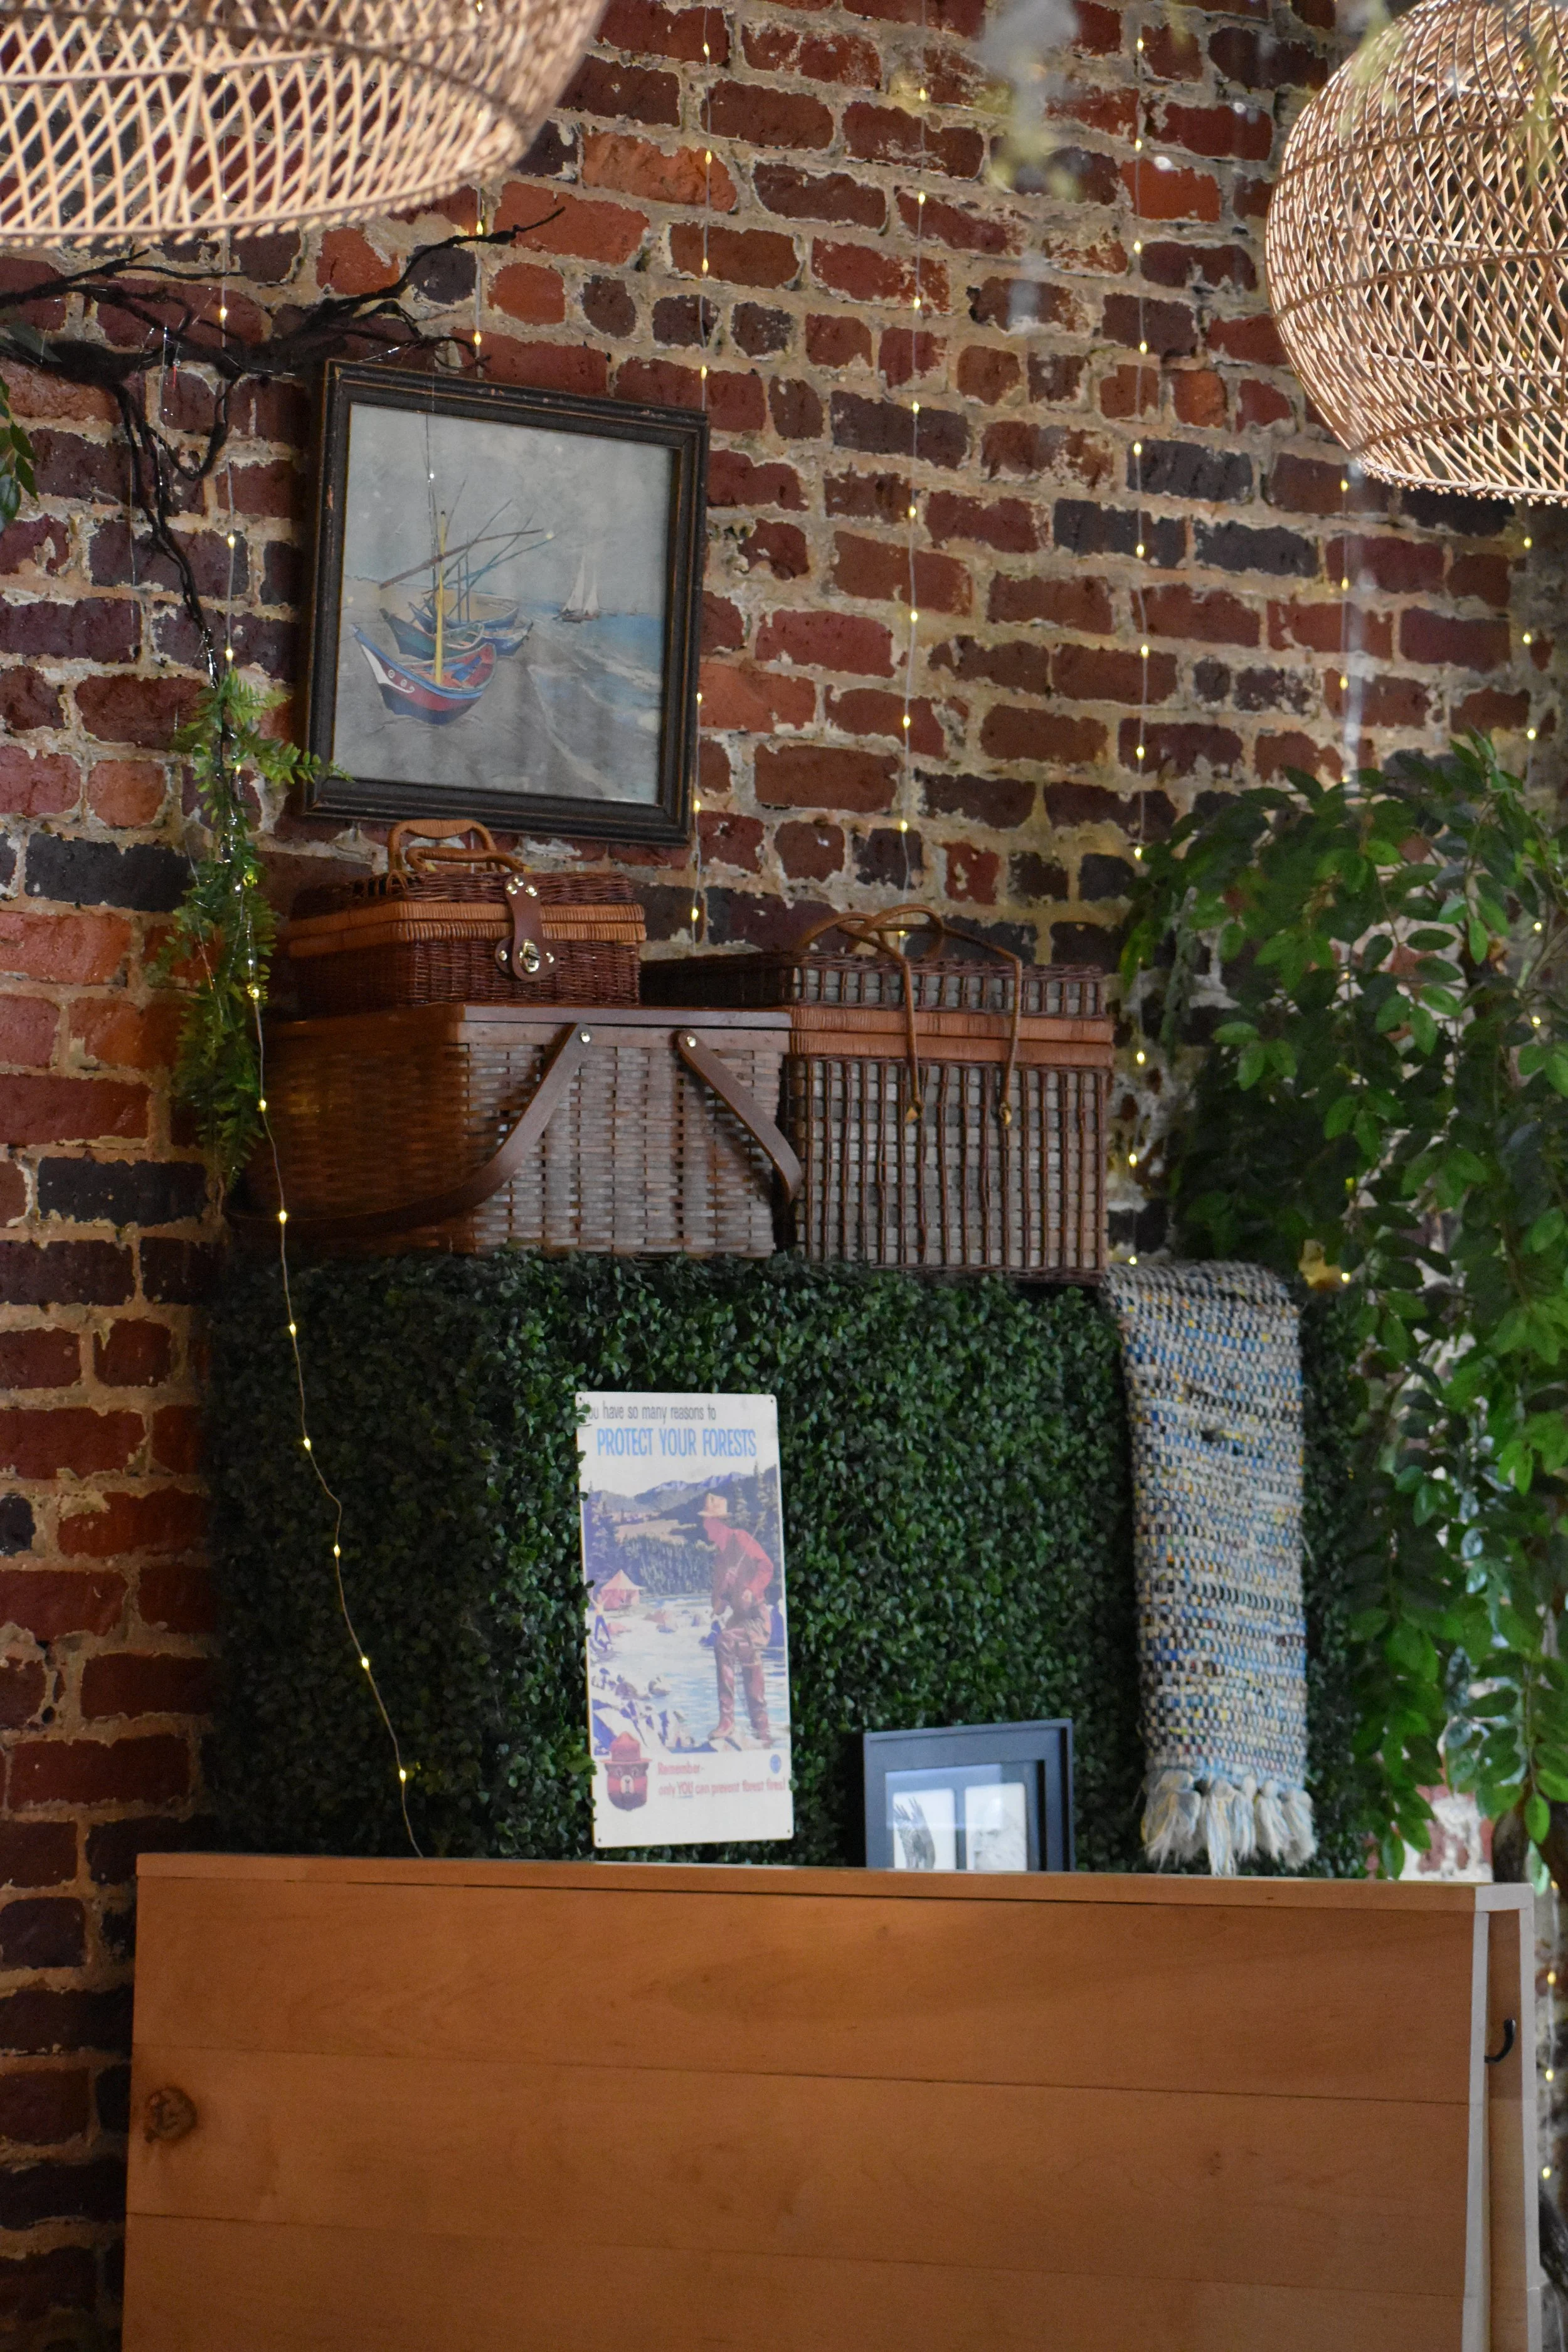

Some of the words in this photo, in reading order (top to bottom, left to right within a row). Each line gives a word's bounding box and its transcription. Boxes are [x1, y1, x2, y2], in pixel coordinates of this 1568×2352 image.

[583, 1401, 599, 1419] ou
[603, 1401, 624, 1419] have
[628, 1406, 638, 1419] so
[642, 1406, 667, 1424] many
[670, 1407, 704, 1420] reasons
[707, 1404, 716, 1420] to
[596, 1428, 654, 1456] PROTECT
[659, 1428, 696, 1456] YOUR
[702, 1429, 756, 1456] FORESTS
[659, 1782, 675, 1798] only
[677, 1781, 693, 1794] YOU
[695, 1784, 709, 1794] can
